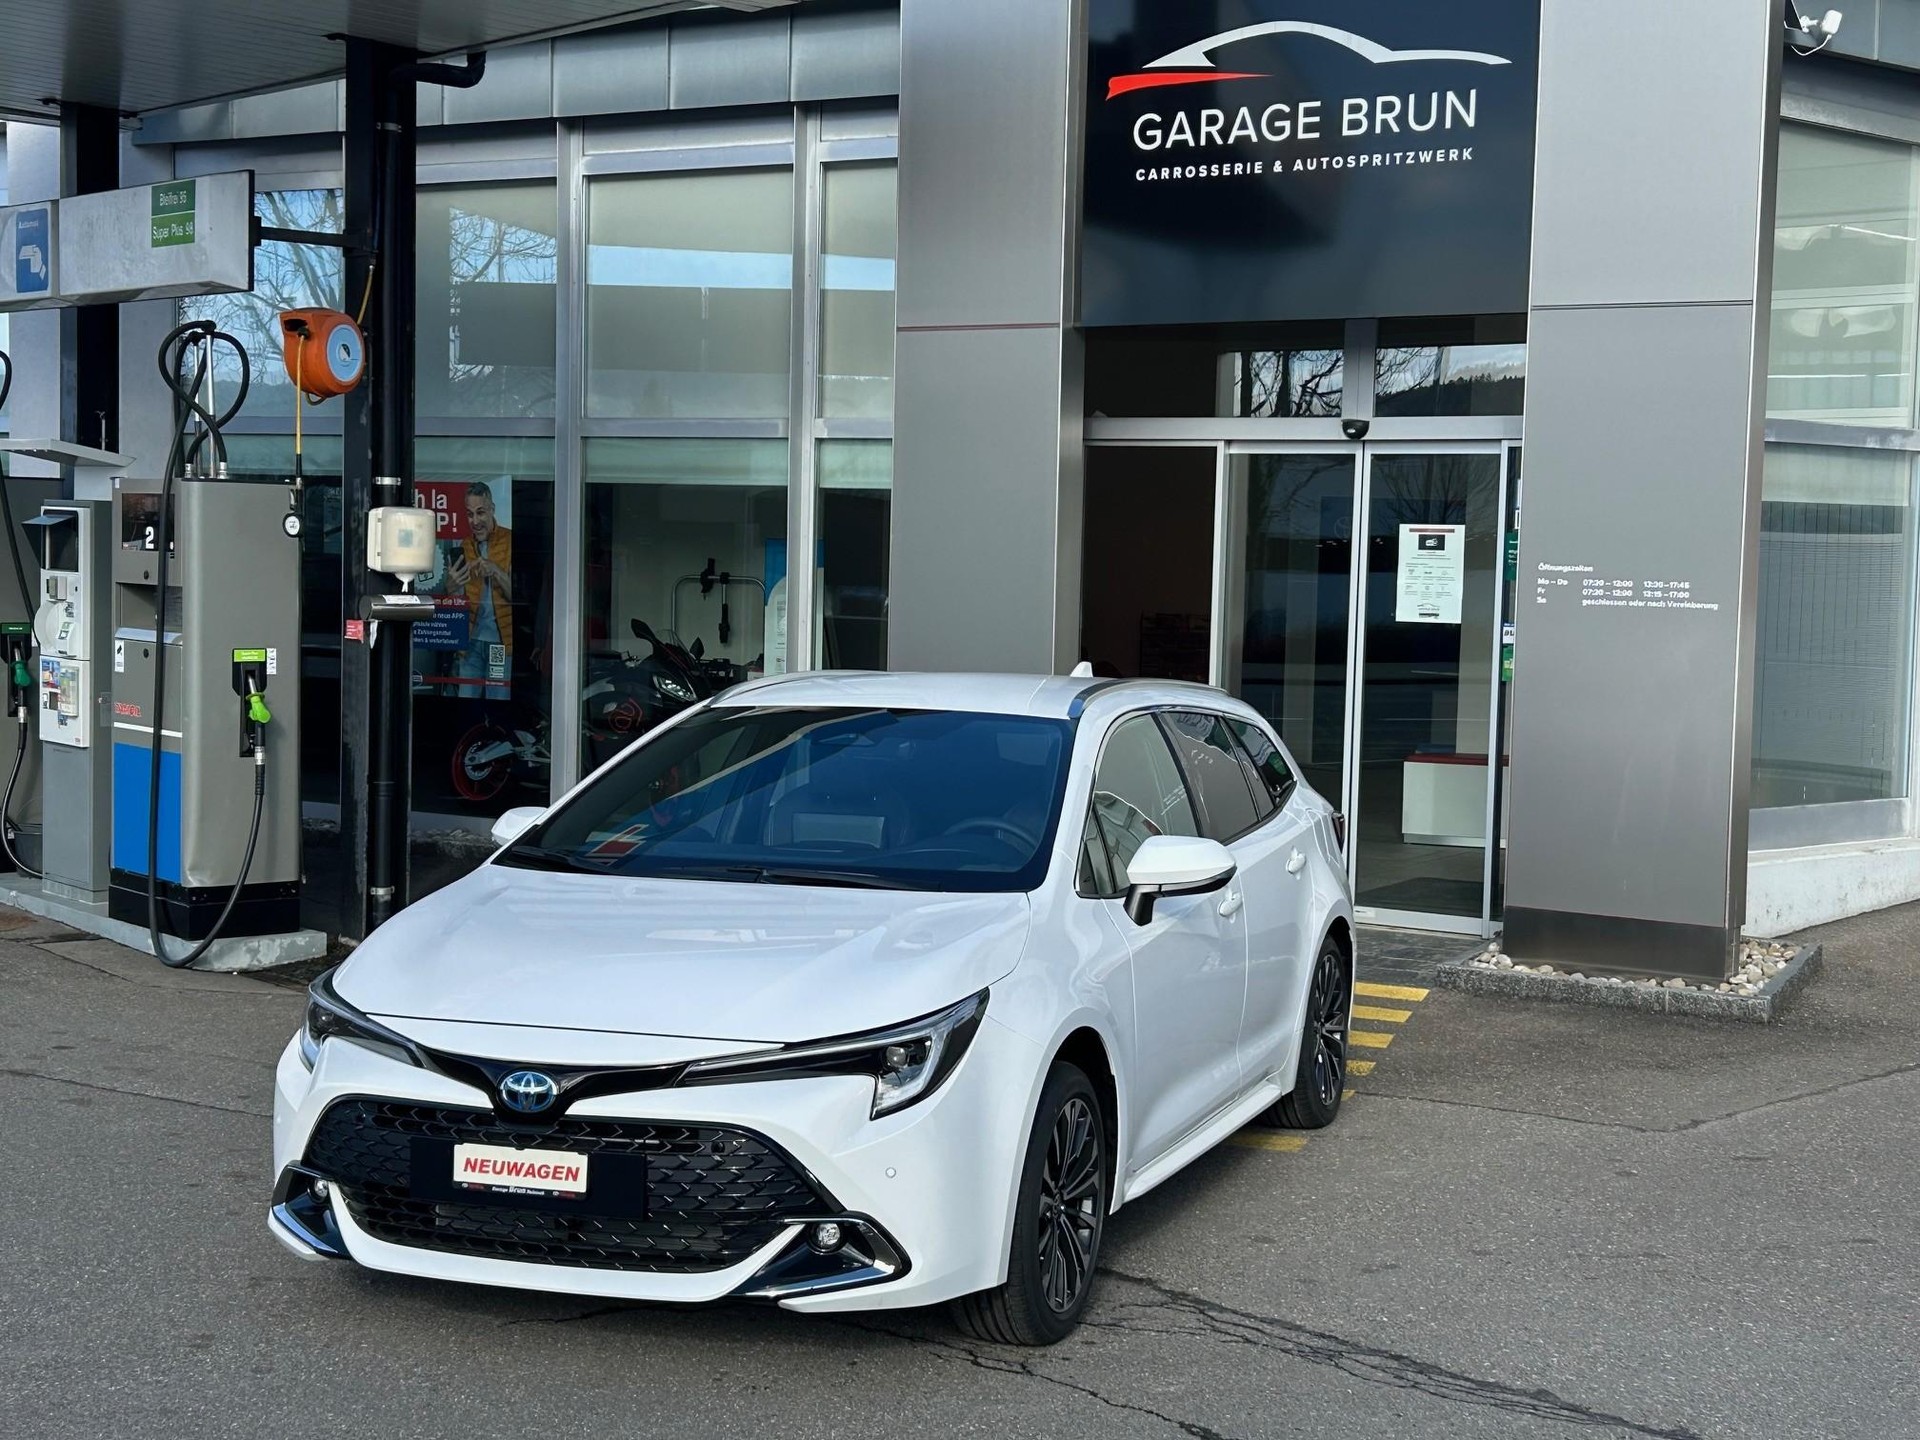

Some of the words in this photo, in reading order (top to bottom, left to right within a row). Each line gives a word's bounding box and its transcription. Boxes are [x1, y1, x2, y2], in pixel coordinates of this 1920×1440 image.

[1133, 101, 1321, 151] GARAGE
[1342, 89, 1477, 137] BRUN
[1135, 162, 1263, 182] CARROSSERIE
[1273, 160, 1283, 172] &
[1293, 147, 1475, 172] AUTOSPRITZWERK
[153, 226, 169, 241] Super
[171, 223, 184, 236] Plus
[431, 488, 448, 509] la
[436, 512, 457, 533] P!
[145, 526, 154, 549] 2
[1537, 577, 1550, 585] Mo
[1557, 578, 1569, 586] Do
[1537, 586, 1546, 594] Fr
[1628, 599, 1645, 607] oder
[463, 1157, 581, 1182] NEUWAGEN
